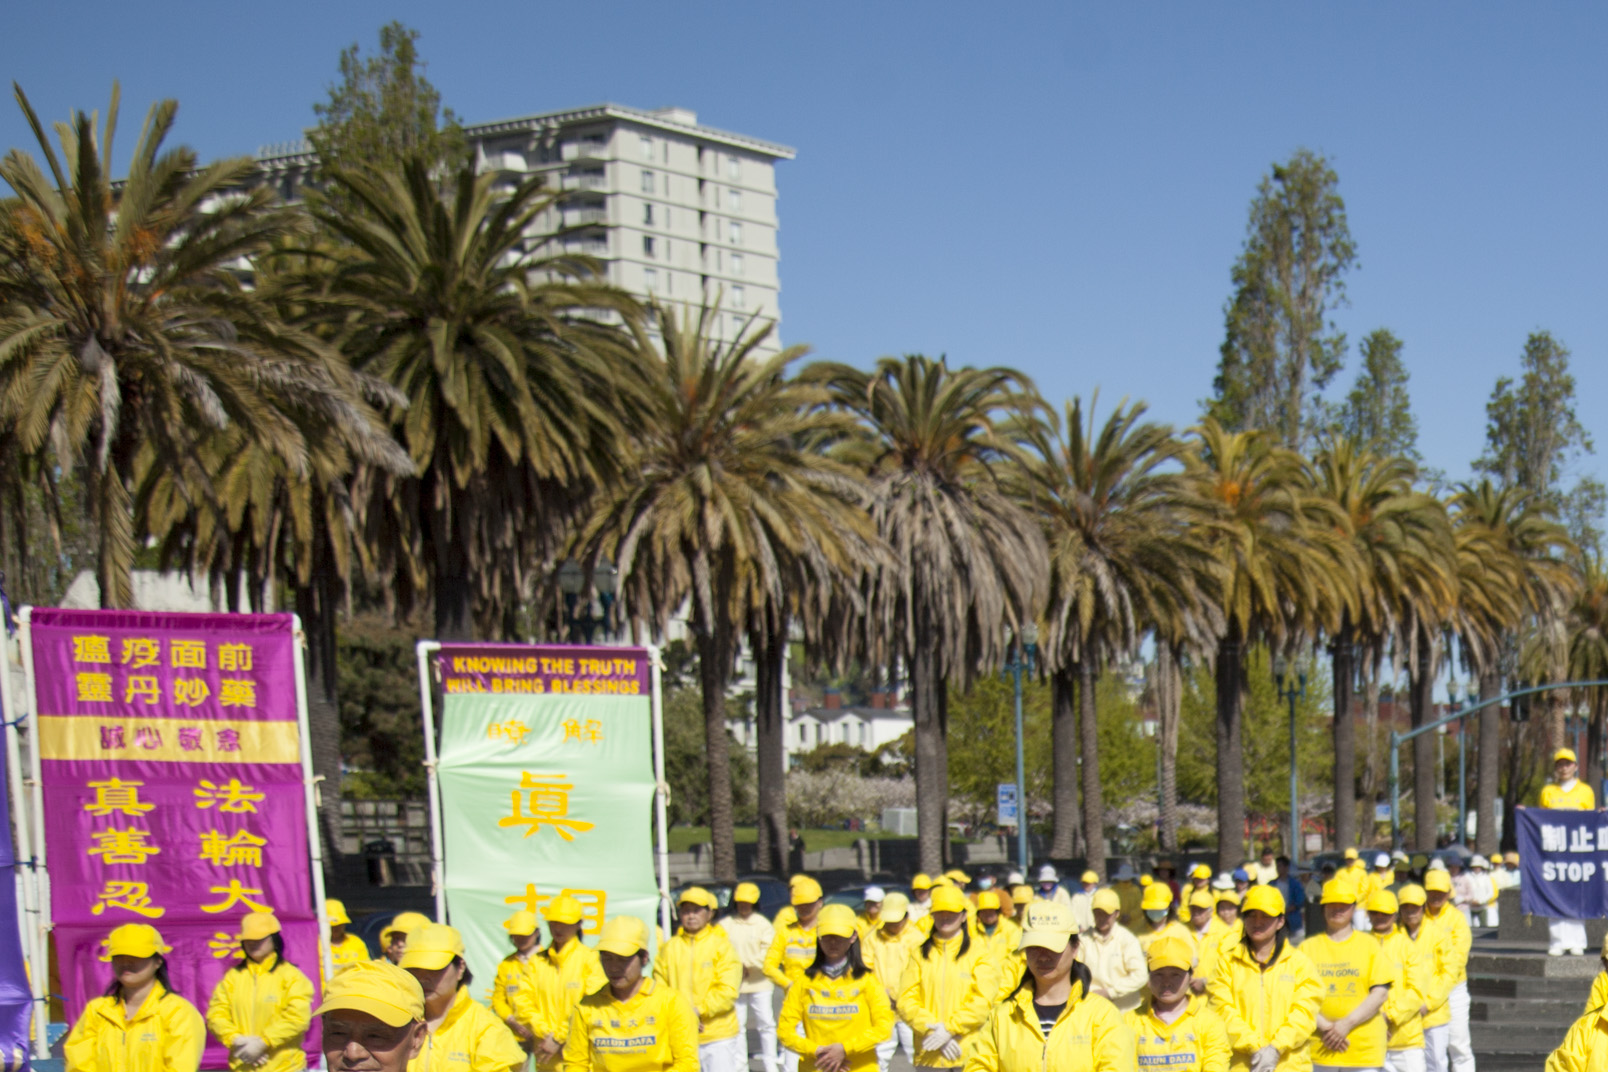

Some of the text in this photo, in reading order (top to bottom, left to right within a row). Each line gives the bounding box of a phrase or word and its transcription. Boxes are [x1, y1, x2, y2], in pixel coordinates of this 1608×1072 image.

[453, 656, 636, 676] KNOWING THE TRUTH
[446, 678, 640, 694] WILL BRING BLESSINGS
[1543, 862, 1595, 882] STOP
